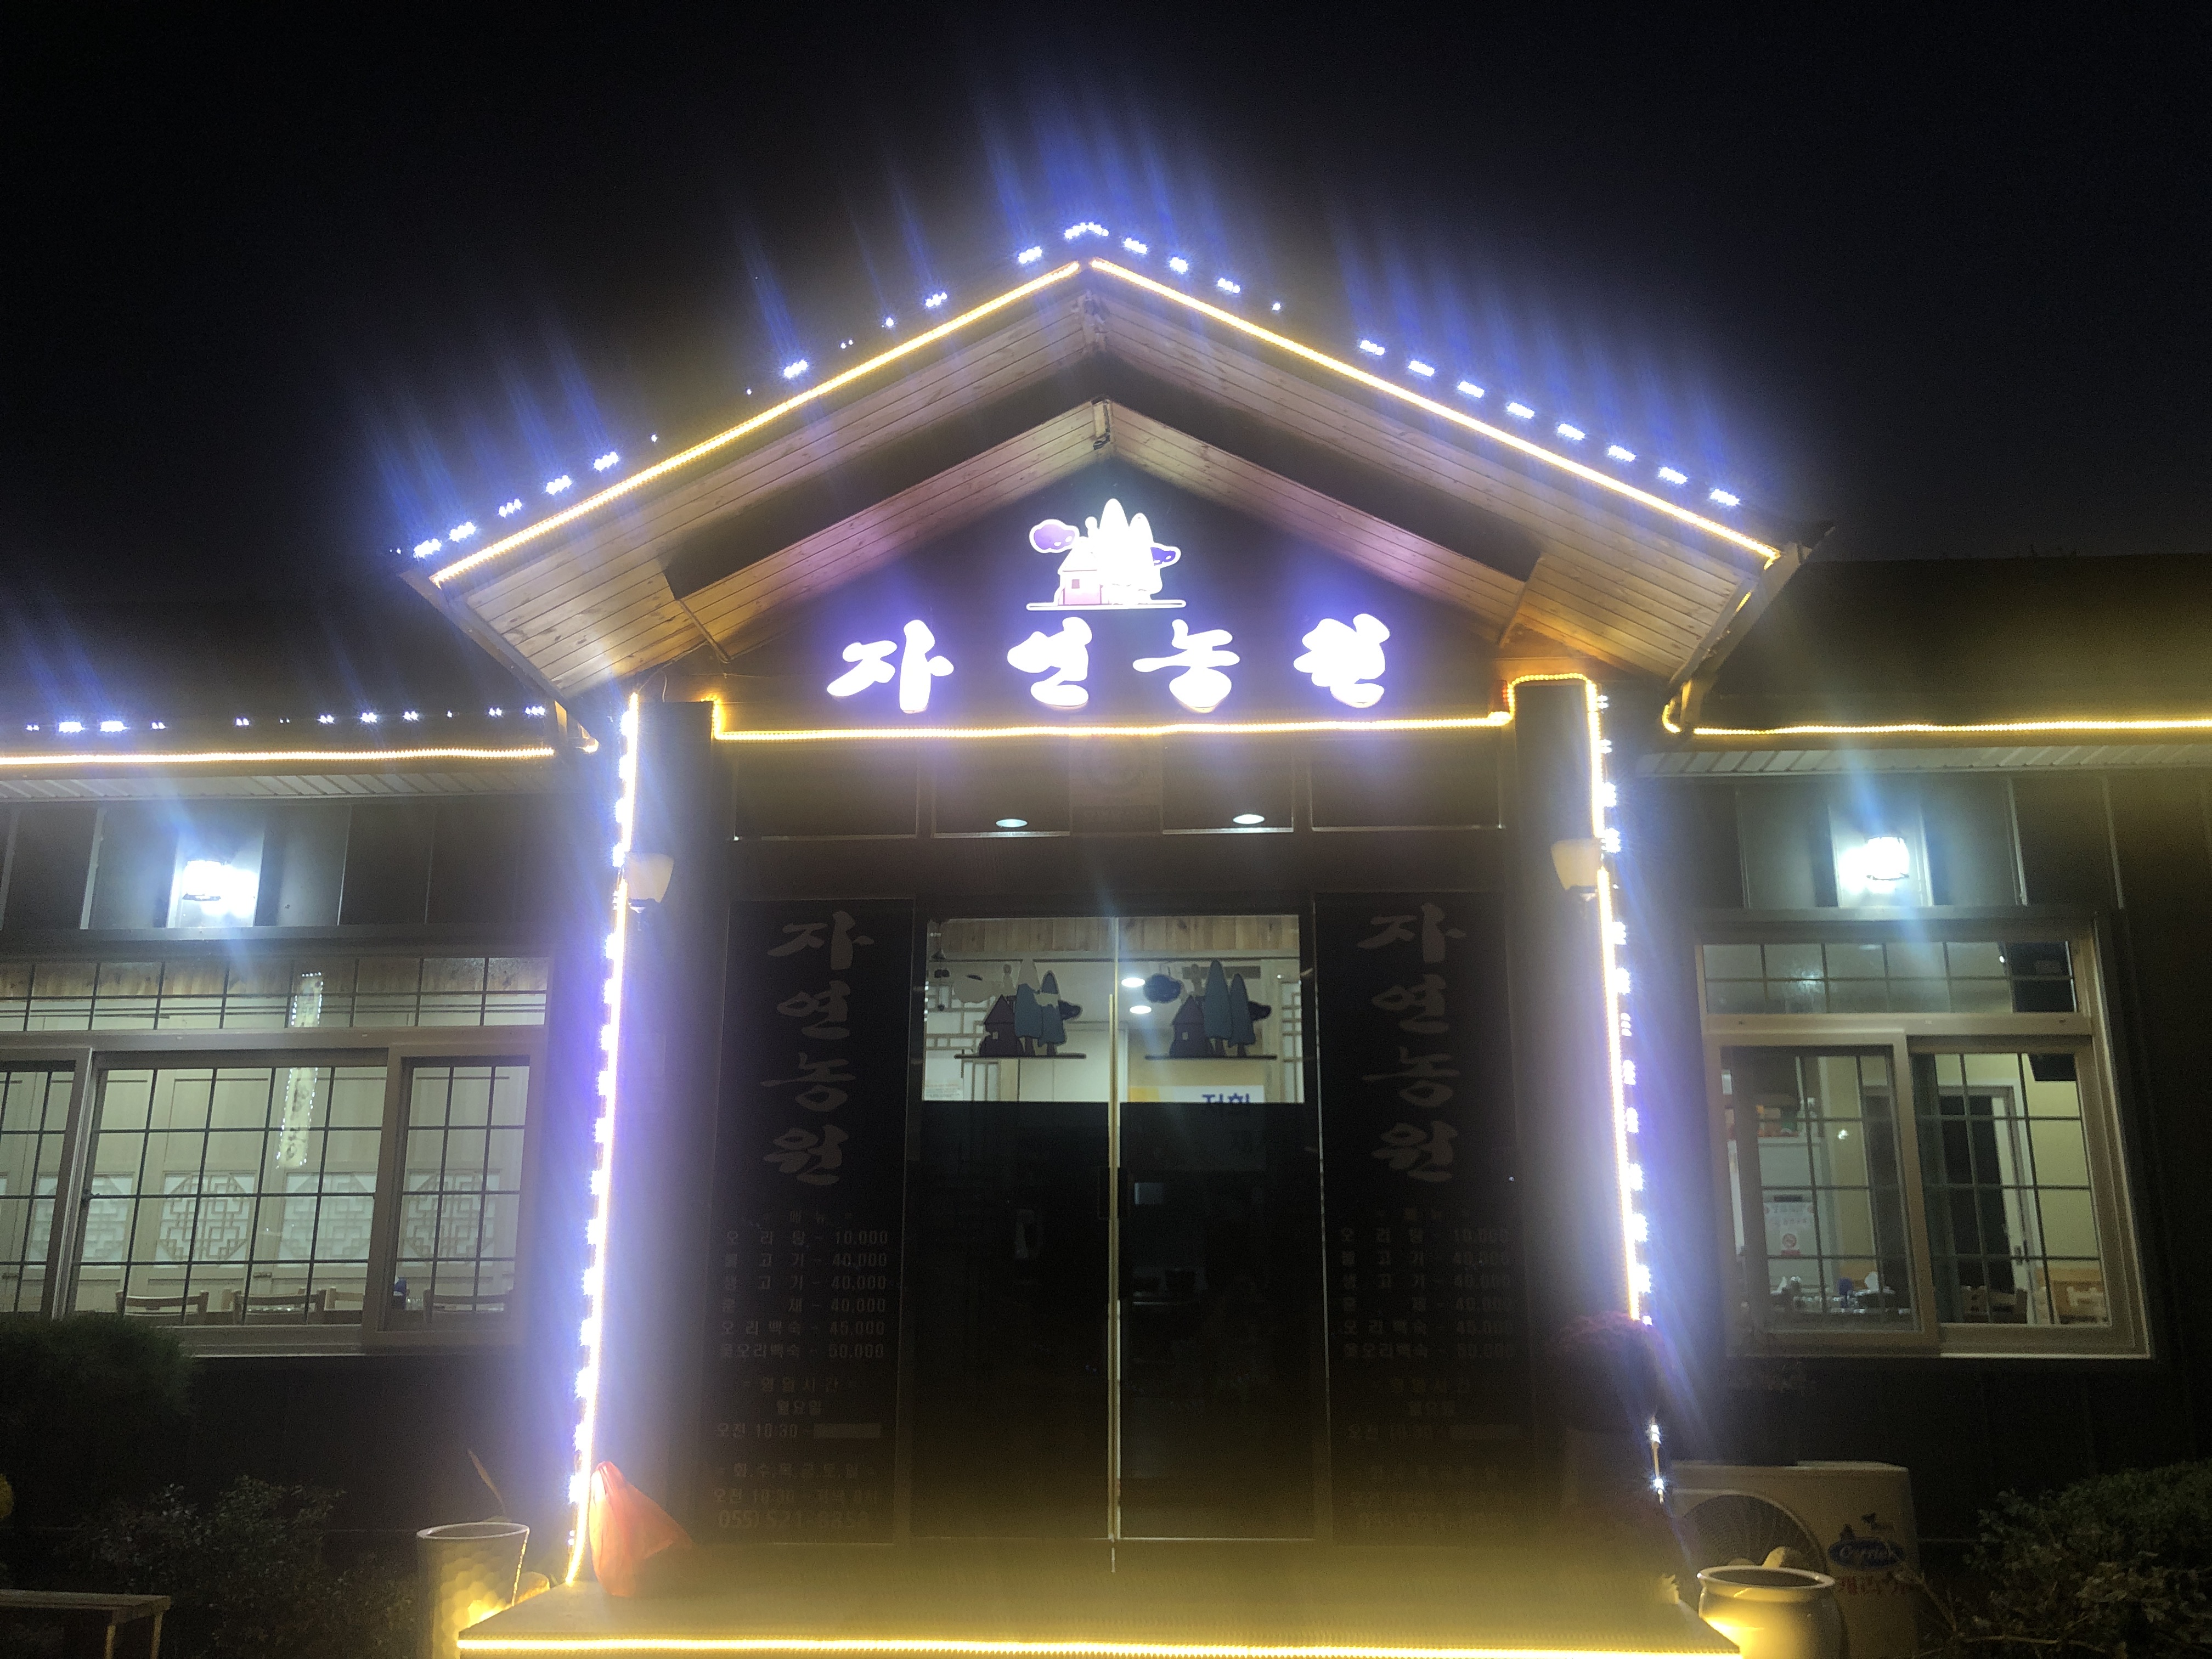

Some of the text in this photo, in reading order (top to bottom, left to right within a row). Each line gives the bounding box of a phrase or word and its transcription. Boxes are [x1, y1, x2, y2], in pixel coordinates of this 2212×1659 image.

[827, 612, 1391, 714] 자연농원
[759, 910, 876, 1186] 자연농원
[1356, 902, 1468, 1182] 자연농원
